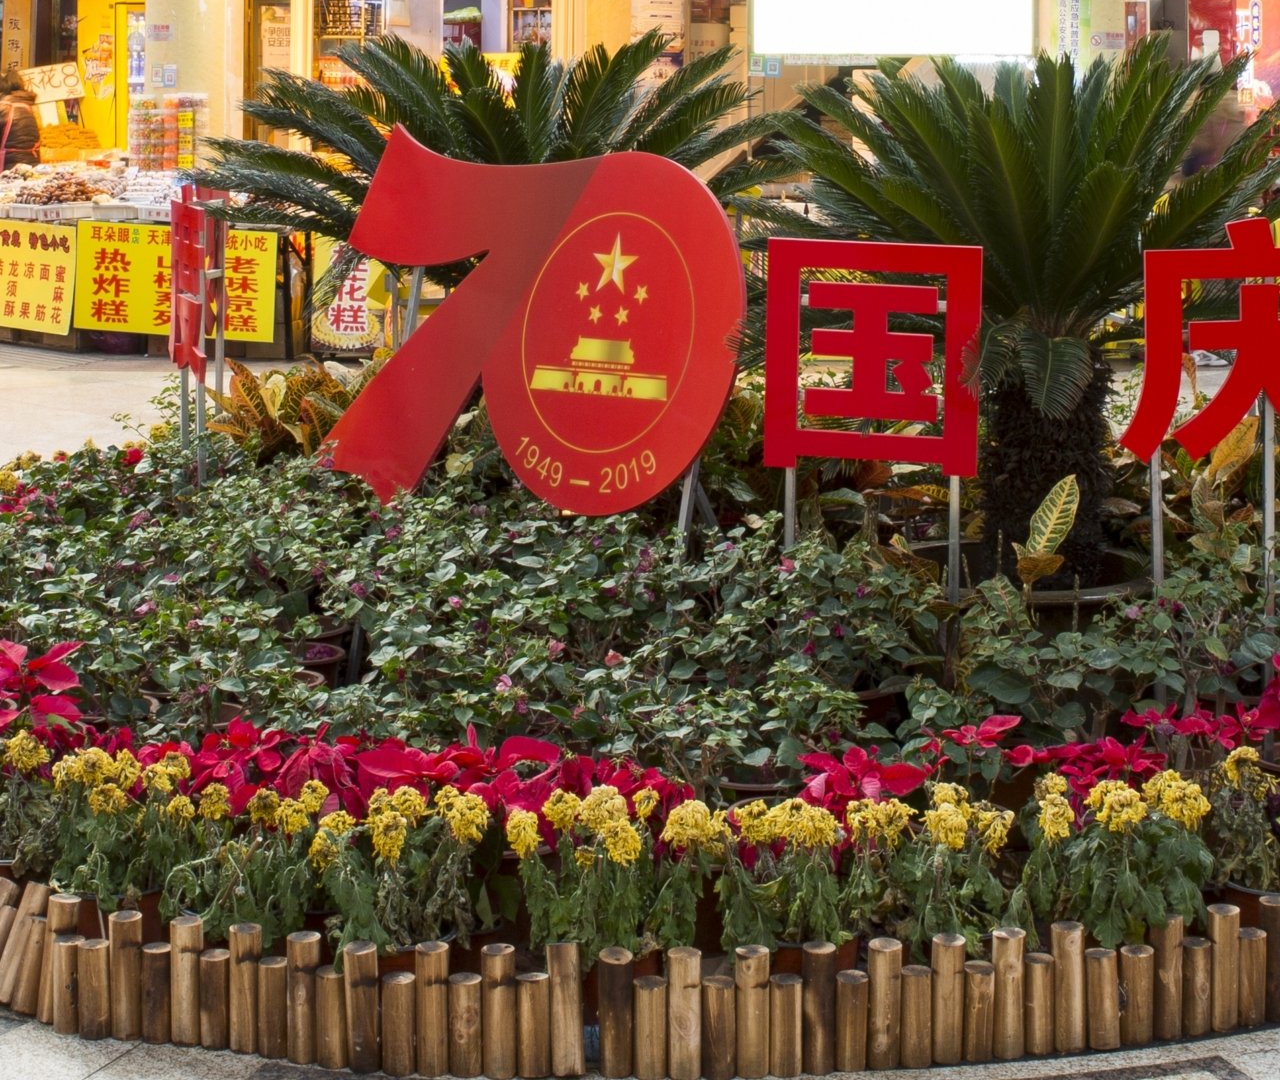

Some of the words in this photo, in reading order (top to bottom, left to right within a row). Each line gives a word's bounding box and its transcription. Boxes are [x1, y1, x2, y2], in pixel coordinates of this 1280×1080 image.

[91, 225, 130, 243] 耳朵眼
[91, 247, 131, 324] 热炸糕
